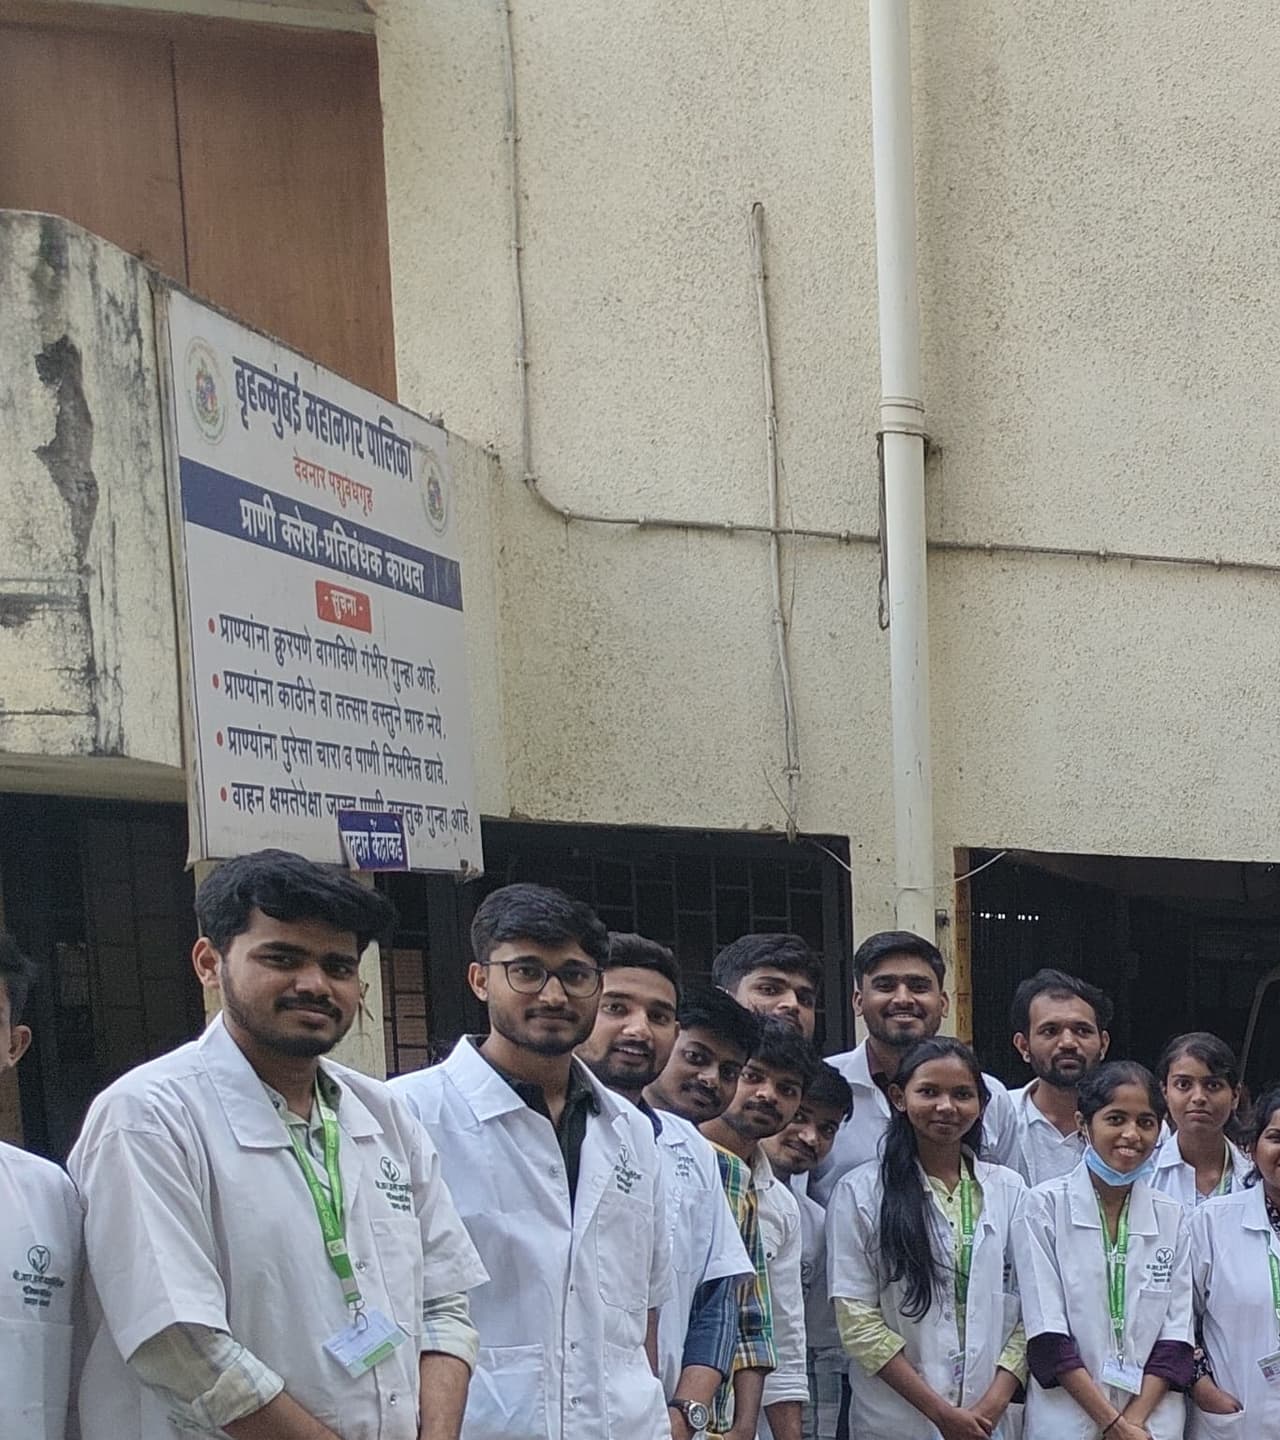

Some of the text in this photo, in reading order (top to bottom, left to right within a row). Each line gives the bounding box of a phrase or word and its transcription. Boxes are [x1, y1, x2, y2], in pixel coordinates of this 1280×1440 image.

[302, 390, 364, 460] महानगर
[364, 415, 413, 482] पालिका
[293, 446, 326, 490] देवनार
[328, 470, 374, 517] पशुवधगृह
[239, 493, 276, 543] प्राणी
[384, 550, 425, 593] कायदा
[219, 613, 269, 653] प्राण्यांना
[315, 634, 358, 674] वागविणे
[361, 643, 388, 680] गंभीर
[390, 658, 414, 693] गुन्हा
[223, 669, 273, 707] प्राण्यांना
[277, 675, 316, 715] काठीने
[319, 690, 332, 718] वा
[335, 694, 368, 726] तत्सम
[227, 723, 277, 761] प्राण्यांना
[281, 725, 312, 773] पुरेसा
[315, 740, 341, 769] चारा
[343, 746, 352, 771] व
[355, 740, 380, 776] पाणी
[383, 743, 422, 781] नियमित
[231, 782, 264, 815] वाहन
[270, 777, 322, 818] क्षमतेपेक्षा
[425, 805, 448, 838] गुन्हा
